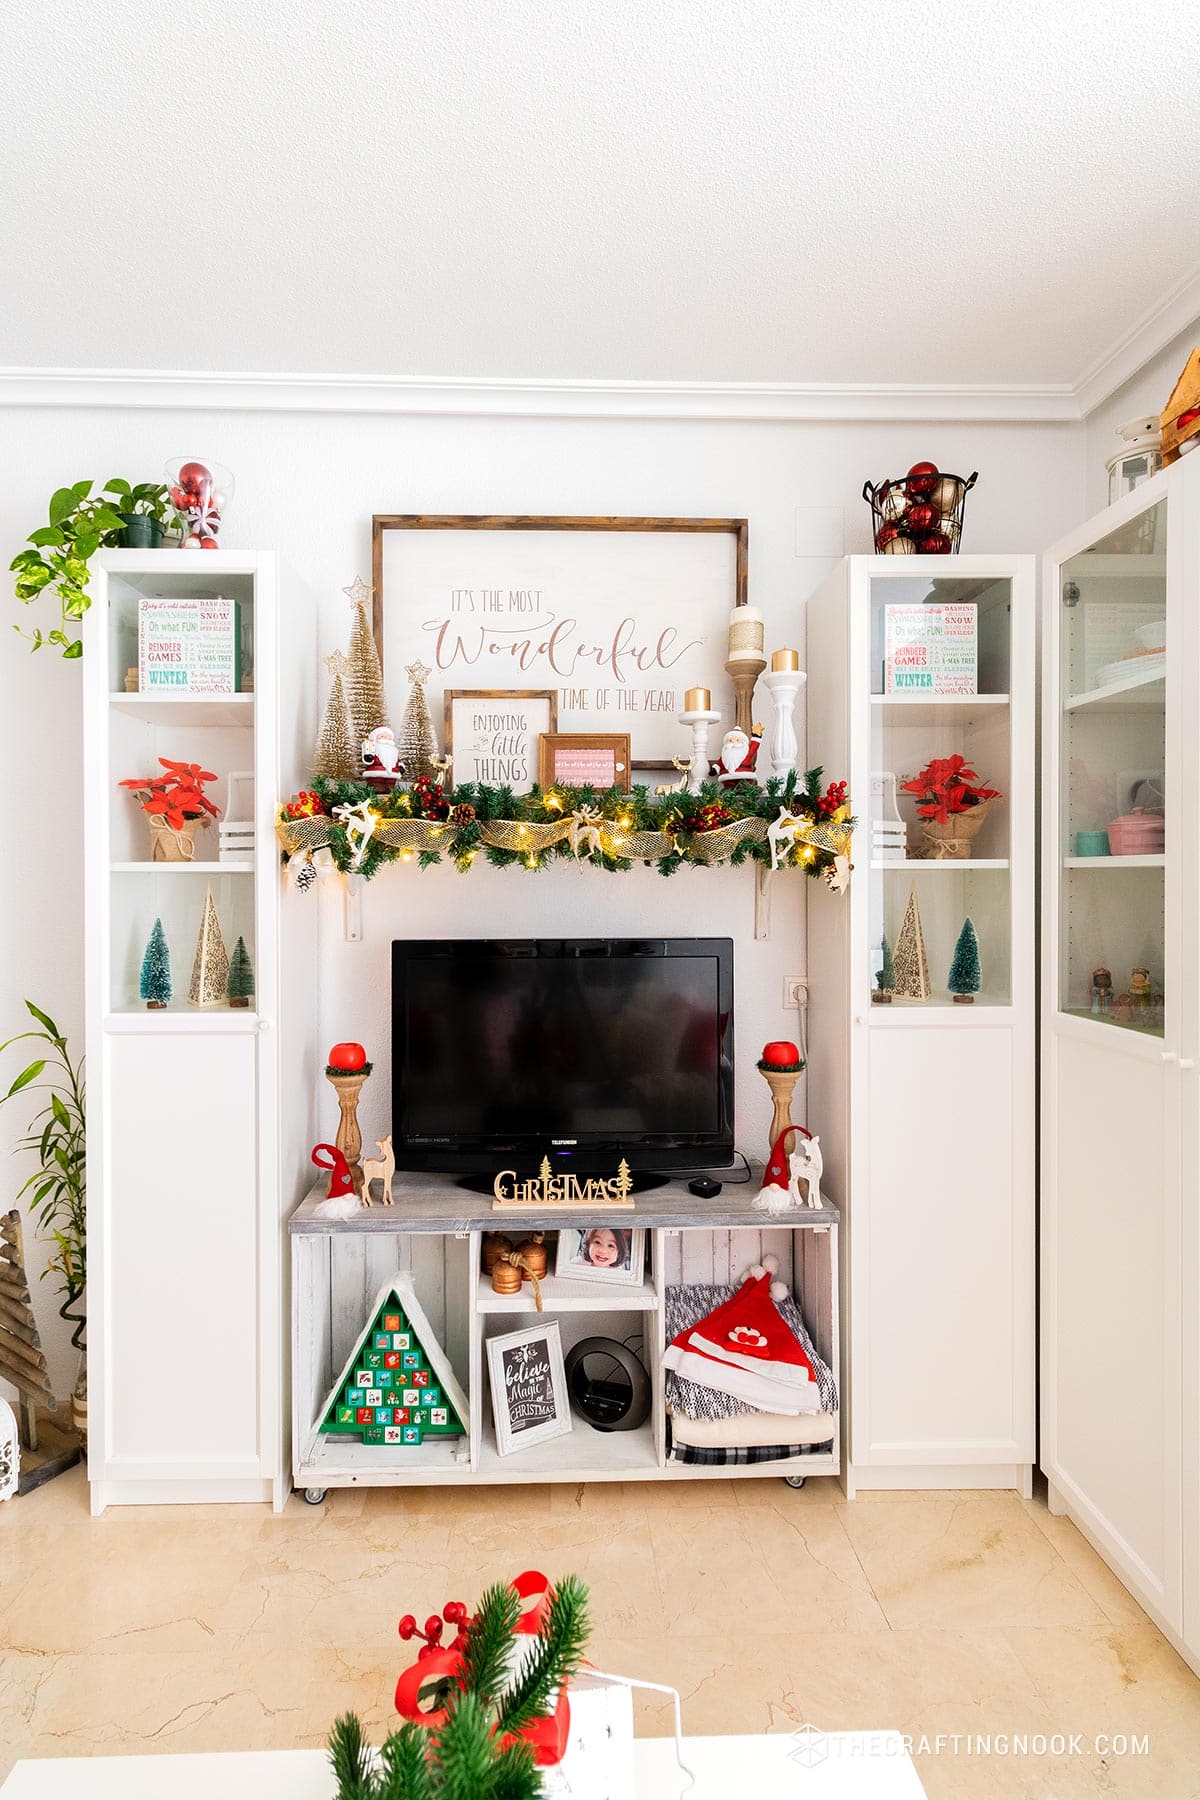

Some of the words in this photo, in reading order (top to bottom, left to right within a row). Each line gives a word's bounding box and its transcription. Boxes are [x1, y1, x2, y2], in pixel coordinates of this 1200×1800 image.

[452, 589, 475, 612] IT'S
[480, 590, 504, 612] THE
[509, 590, 544, 612] MOST
[200, 612, 229, 620] SNOW
[945, 616, 973, 624] SNOW
[161, 621, 179, 632] what
[149, 642, 182, 652] REINDEER
[421, 612, 704, 683] Wonderful
[148, 652, 182, 662] GAMES
[895, 656, 927, 665] GAMES
[149, 671, 188, 685] WINTER
[895, 673, 933, 687] WINTER
[560, 688, 589, 711] TIME
[596, 688, 610, 710] OF
[616, 688, 639, 711] THE
[644, 690, 675, 712] YEAR!
[473, 714, 527, 732] ENJOYING
[491, 732, 528, 756] little
[473, 758, 528, 781] THINGS
[493, 1166, 622, 1202] CHRISTMAS
[506, 1362, 550, 1386] believe
[508, 1383, 542, 1403] Magic
[510, 1404, 555, 1422] CHRISTMAS
